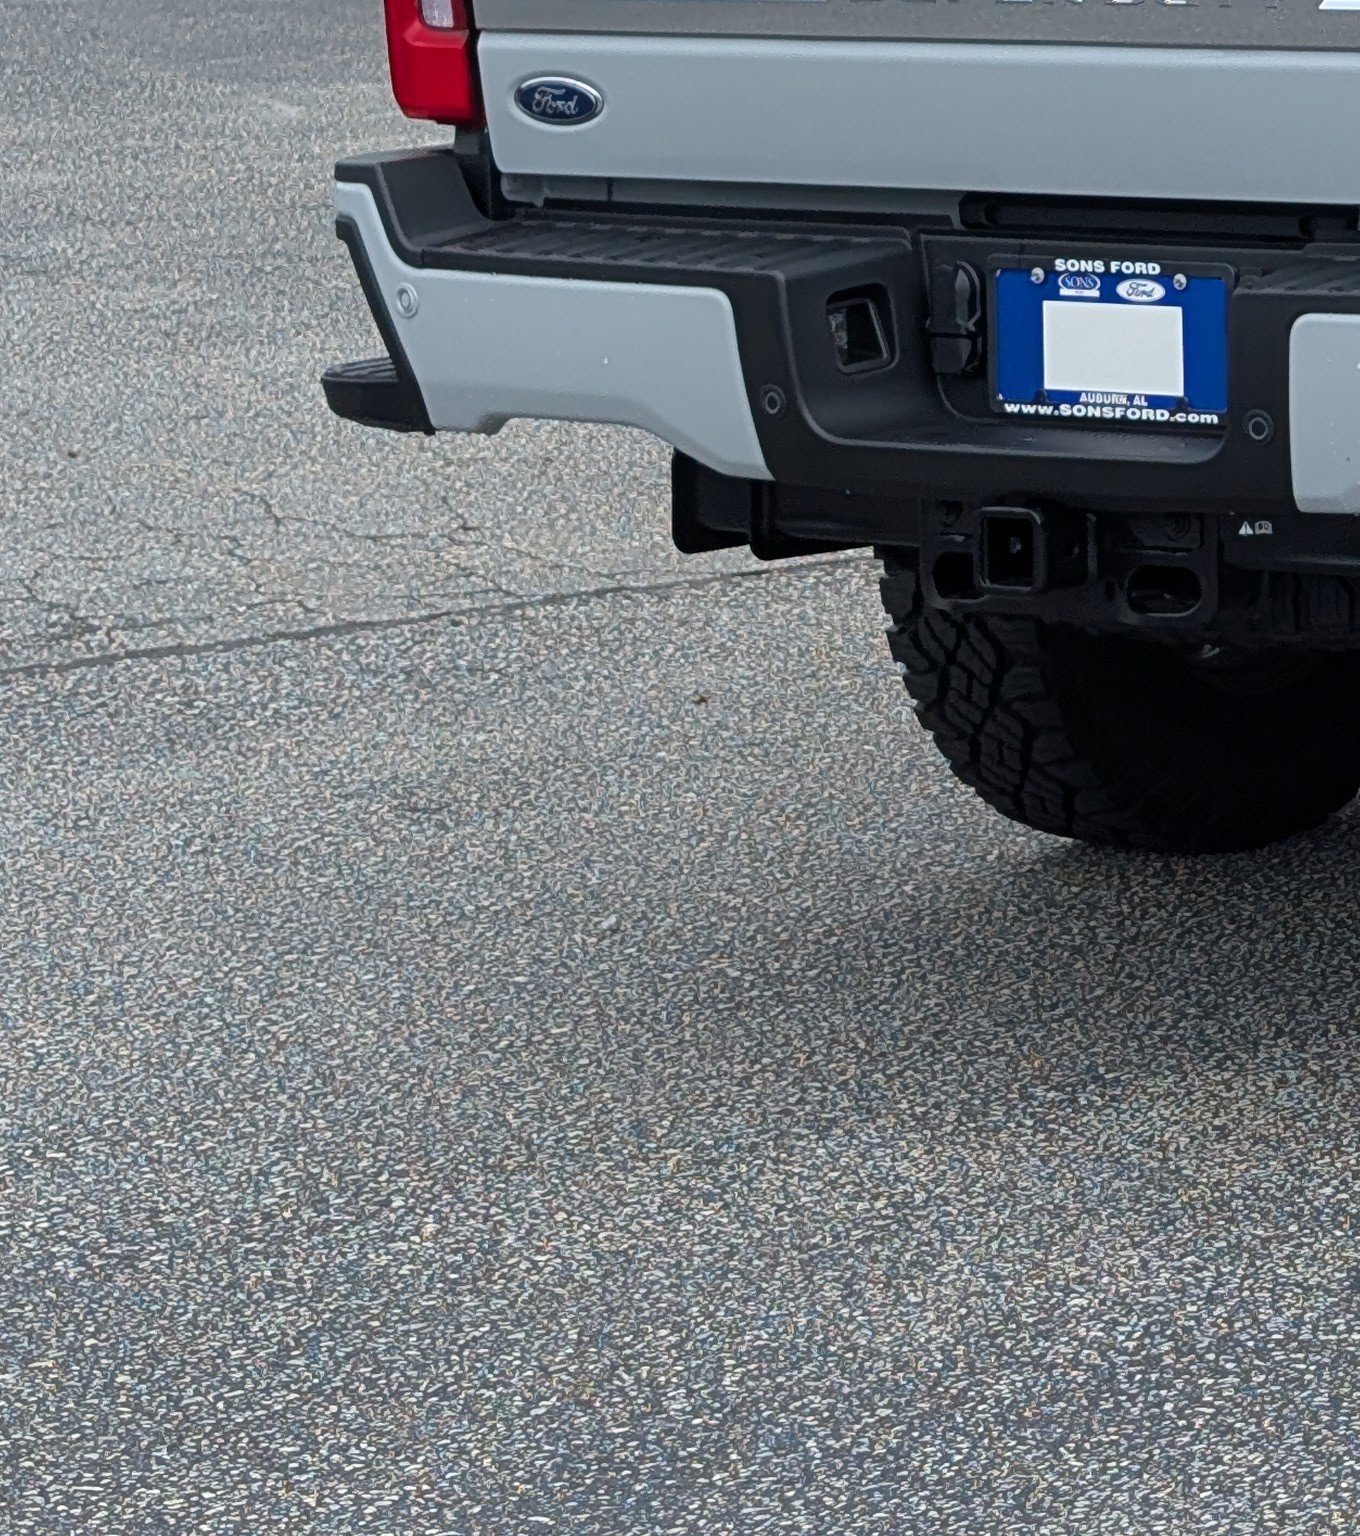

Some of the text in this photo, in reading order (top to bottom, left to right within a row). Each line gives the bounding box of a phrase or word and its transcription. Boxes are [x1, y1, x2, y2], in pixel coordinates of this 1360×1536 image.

[532, 86, 579, 115] Ford
[1054, 258, 1161, 275] SONS FORD
[1125, 282, 1155, 298] Ford
[1133, 395, 1148, 406] AL
[1004, 403, 1219, 424] www.SONSFORD.com
